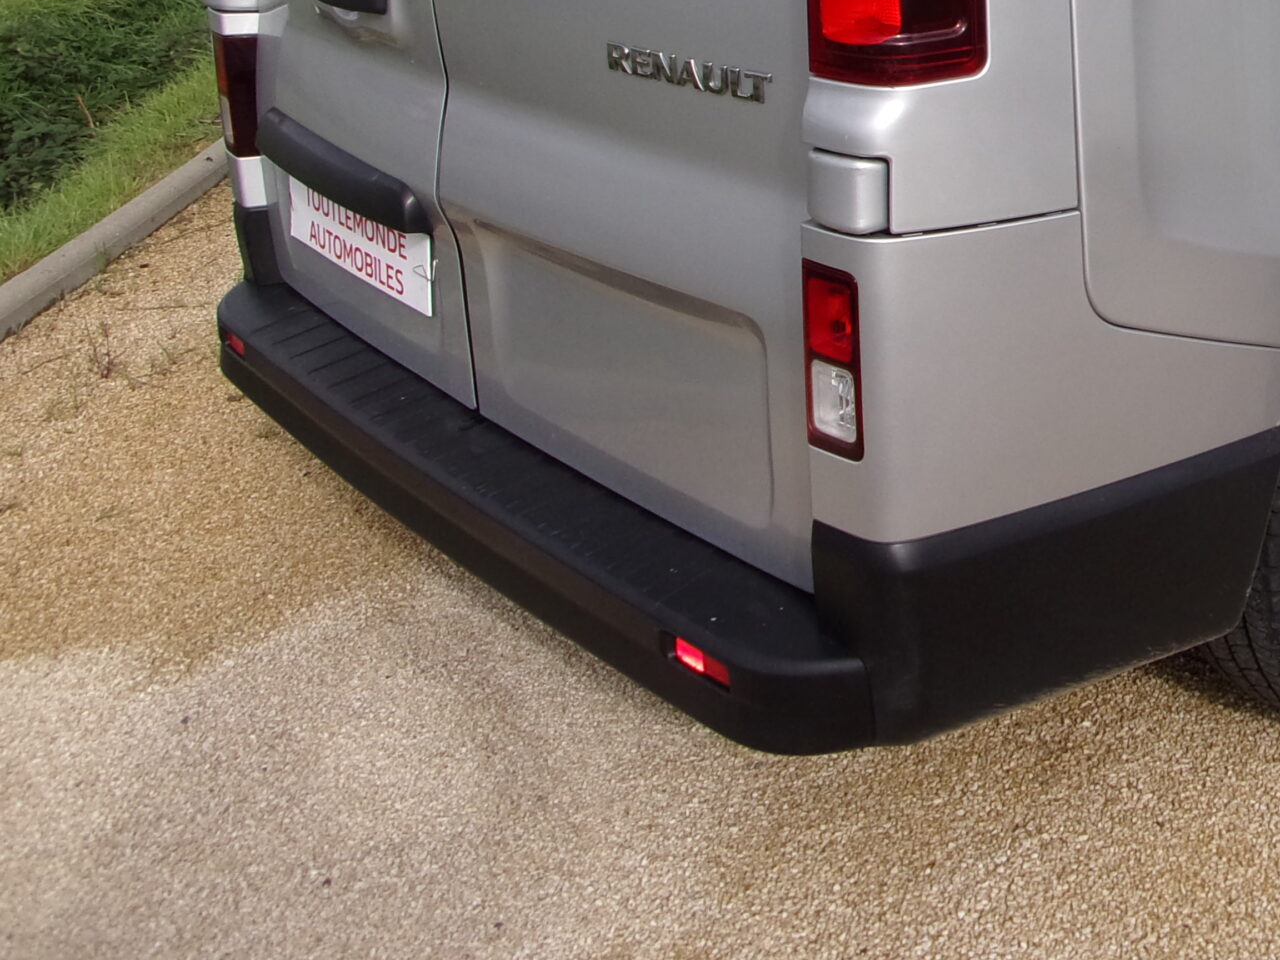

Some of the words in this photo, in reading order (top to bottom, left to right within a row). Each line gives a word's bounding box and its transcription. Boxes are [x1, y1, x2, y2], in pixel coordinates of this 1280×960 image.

[606, 40, 773, 104] RENAULT
[306, 187, 408, 261] TOUTLEMONDE
[309, 220, 405, 296] AUTOMOBILES
